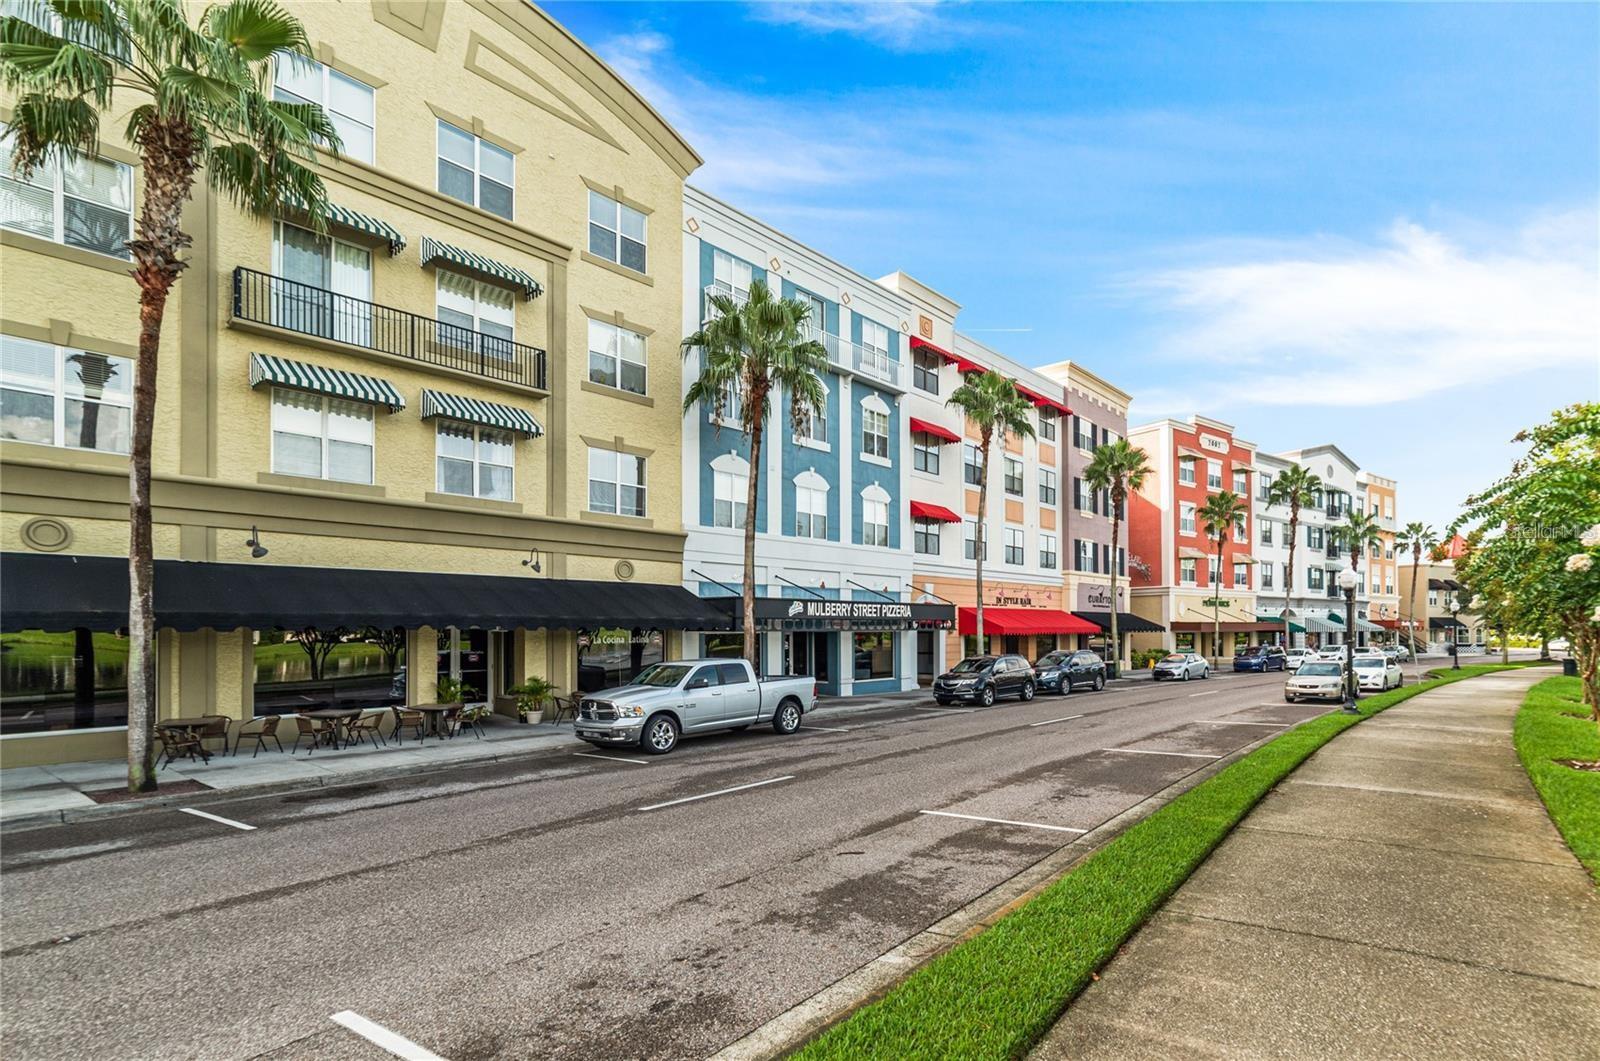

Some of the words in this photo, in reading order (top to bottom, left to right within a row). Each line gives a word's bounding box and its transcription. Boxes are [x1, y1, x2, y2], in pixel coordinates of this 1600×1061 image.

[807, 602, 851, 616] MULBERRY
[853, 603, 880, 617] STREET
[882, 604, 911, 617] PIZZERIA
[593, 636, 601, 644] La
[602, 634, 624, 644] Cocina
